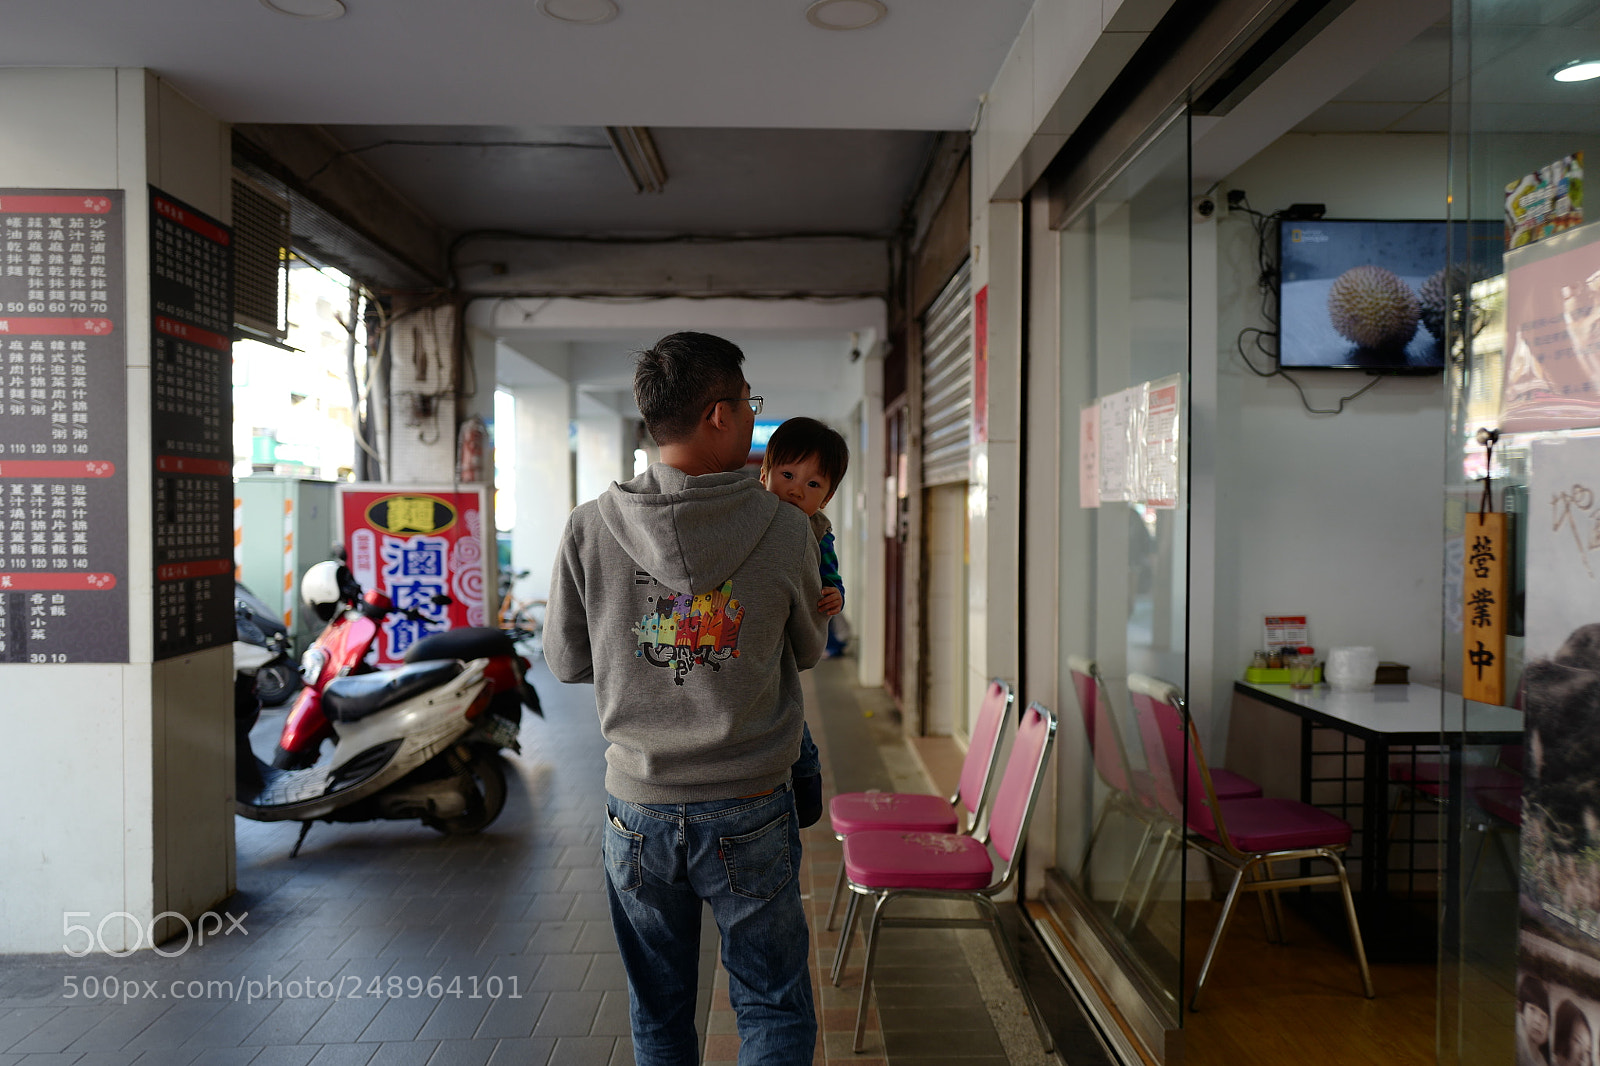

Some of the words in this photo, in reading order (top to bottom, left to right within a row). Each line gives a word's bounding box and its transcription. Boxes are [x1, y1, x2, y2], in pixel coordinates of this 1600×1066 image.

[7, 302, 24, 313] 50
[28, 302, 45, 313] 60
[49, 302, 66, 313] 60
[69, 302, 87, 313] 70
[90, 302, 108, 313] 70
[10, 444, 26, 454] 110
[31, 444, 47, 454] 120
[52, 444, 68, 454] 130
[72, 444, 88, 454] 140
[10, 558, 26, 569] 110
[31, 558, 47, 569] 120
[52, 558, 68, 569] 130
[73, 558, 88, 569] 140
[50, 593, 67, 617] 白飯
[1468, 535, 1496, 681] 營業中
[30, 593, 47, 640] 各式小菜
[30, 653, 47, 664] 30
[51, 653, 67, 664] 10
